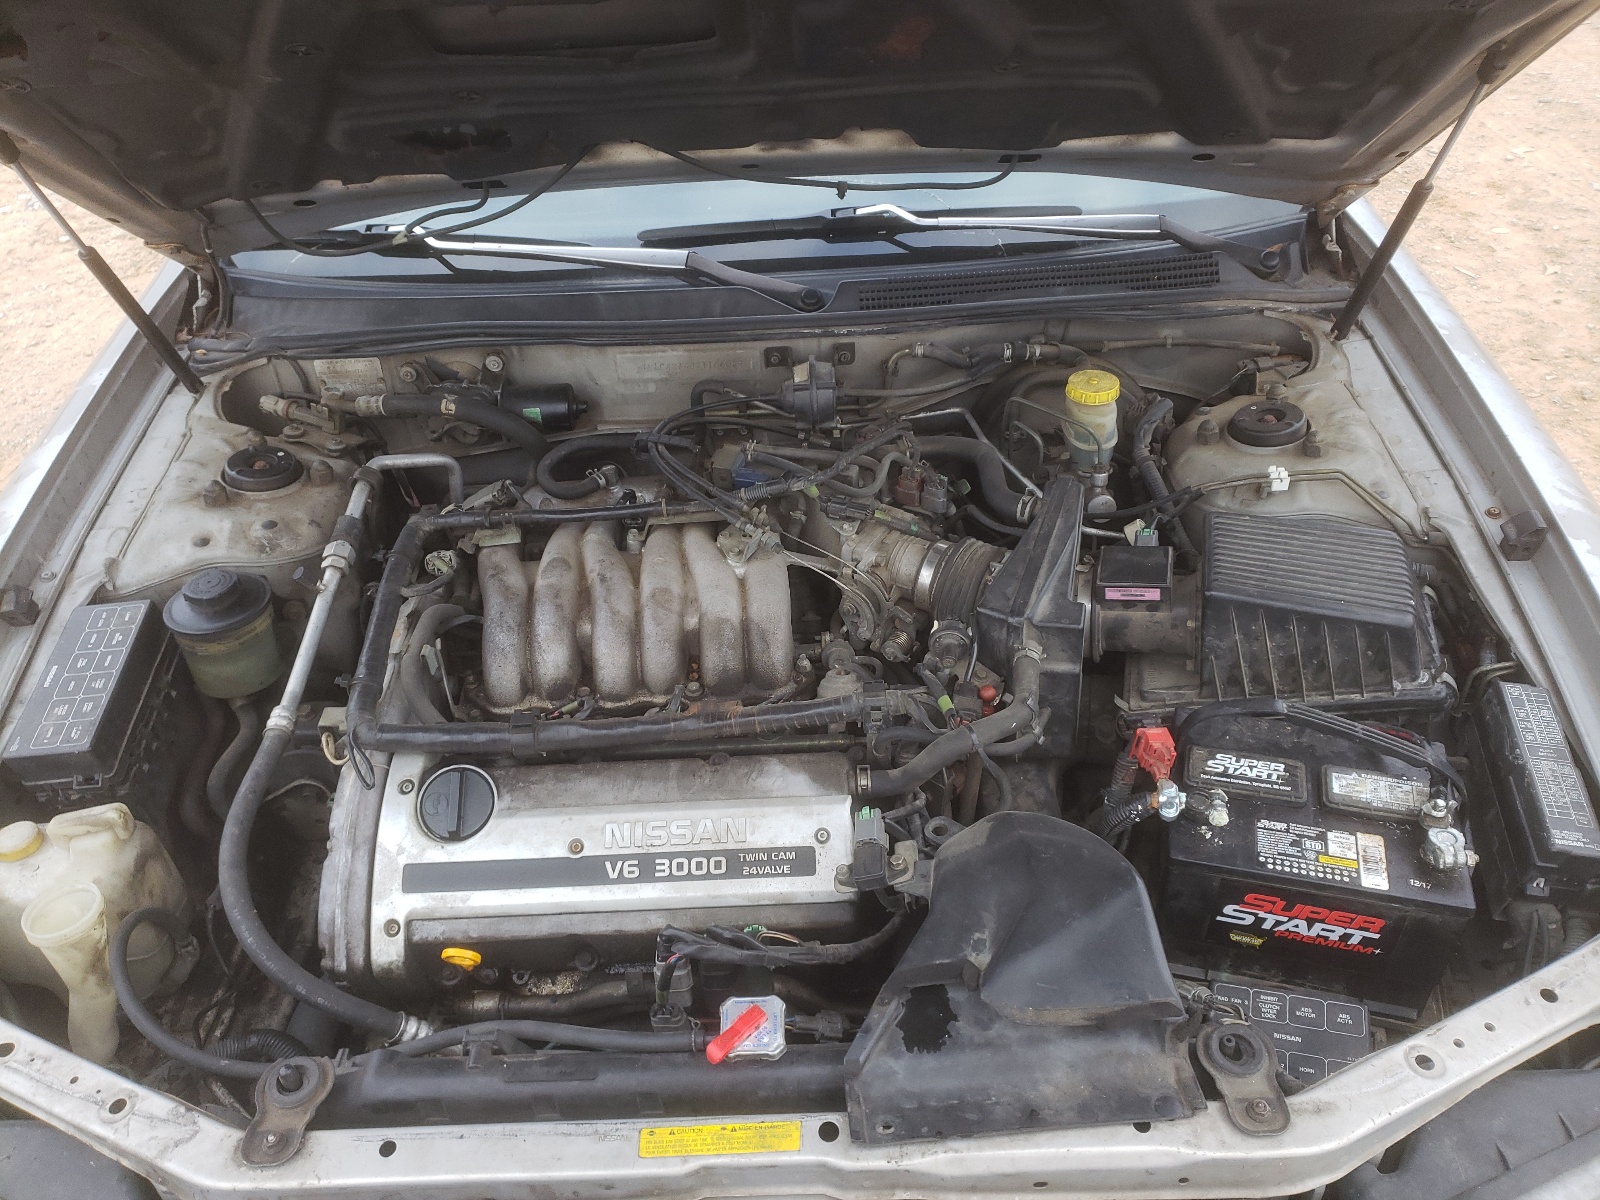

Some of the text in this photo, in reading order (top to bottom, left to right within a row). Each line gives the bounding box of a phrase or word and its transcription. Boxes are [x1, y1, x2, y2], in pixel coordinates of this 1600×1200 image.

[1204, 759, 1286, 781] START
[1215, 753, 1286, 772] SUPER
[603, 816, 748, 849] NISSAN
[604, 851, 796, 880] V6 3000 TWIN CAM
[742, 864, 791, 875] 24VALVE
[1409, 878, 1431, 890] 12/17
[1239, 893, 1387, 932] SUPER
[1215, 904, 1382, 945] START
[1273, 929, 1375, 955] PREMIUM
[1295, 1010, 1316, 1019] MOTOR
[1273, 1032, 1302, 1043] NISSAN
